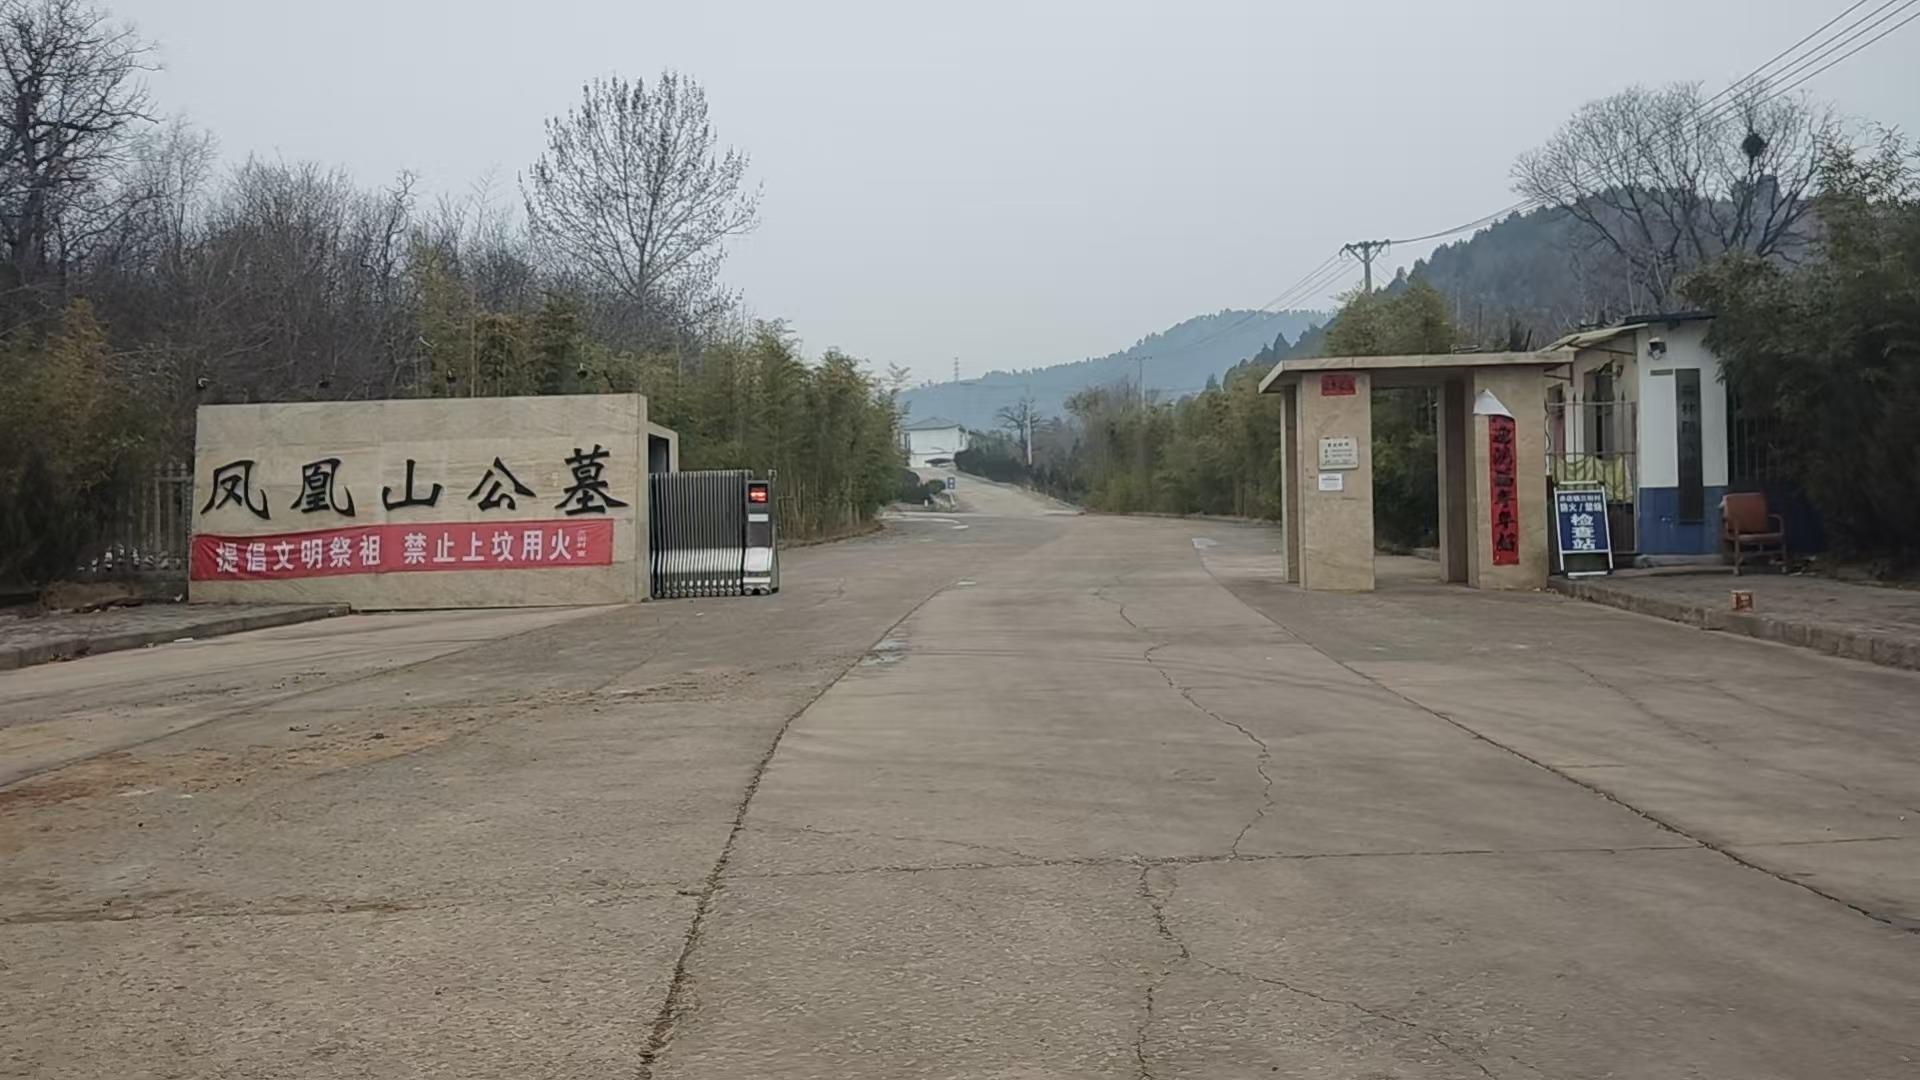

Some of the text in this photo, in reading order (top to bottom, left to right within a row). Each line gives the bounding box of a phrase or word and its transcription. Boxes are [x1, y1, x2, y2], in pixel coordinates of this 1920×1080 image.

[200, 444, 629, 520] 凤凰山公墓
[215, 534, 381, 573] 提倡文明祭祖
[404, 528, 572, 565] 禁止上坟用火
[1570, 513, 1596, 550] 检查站
